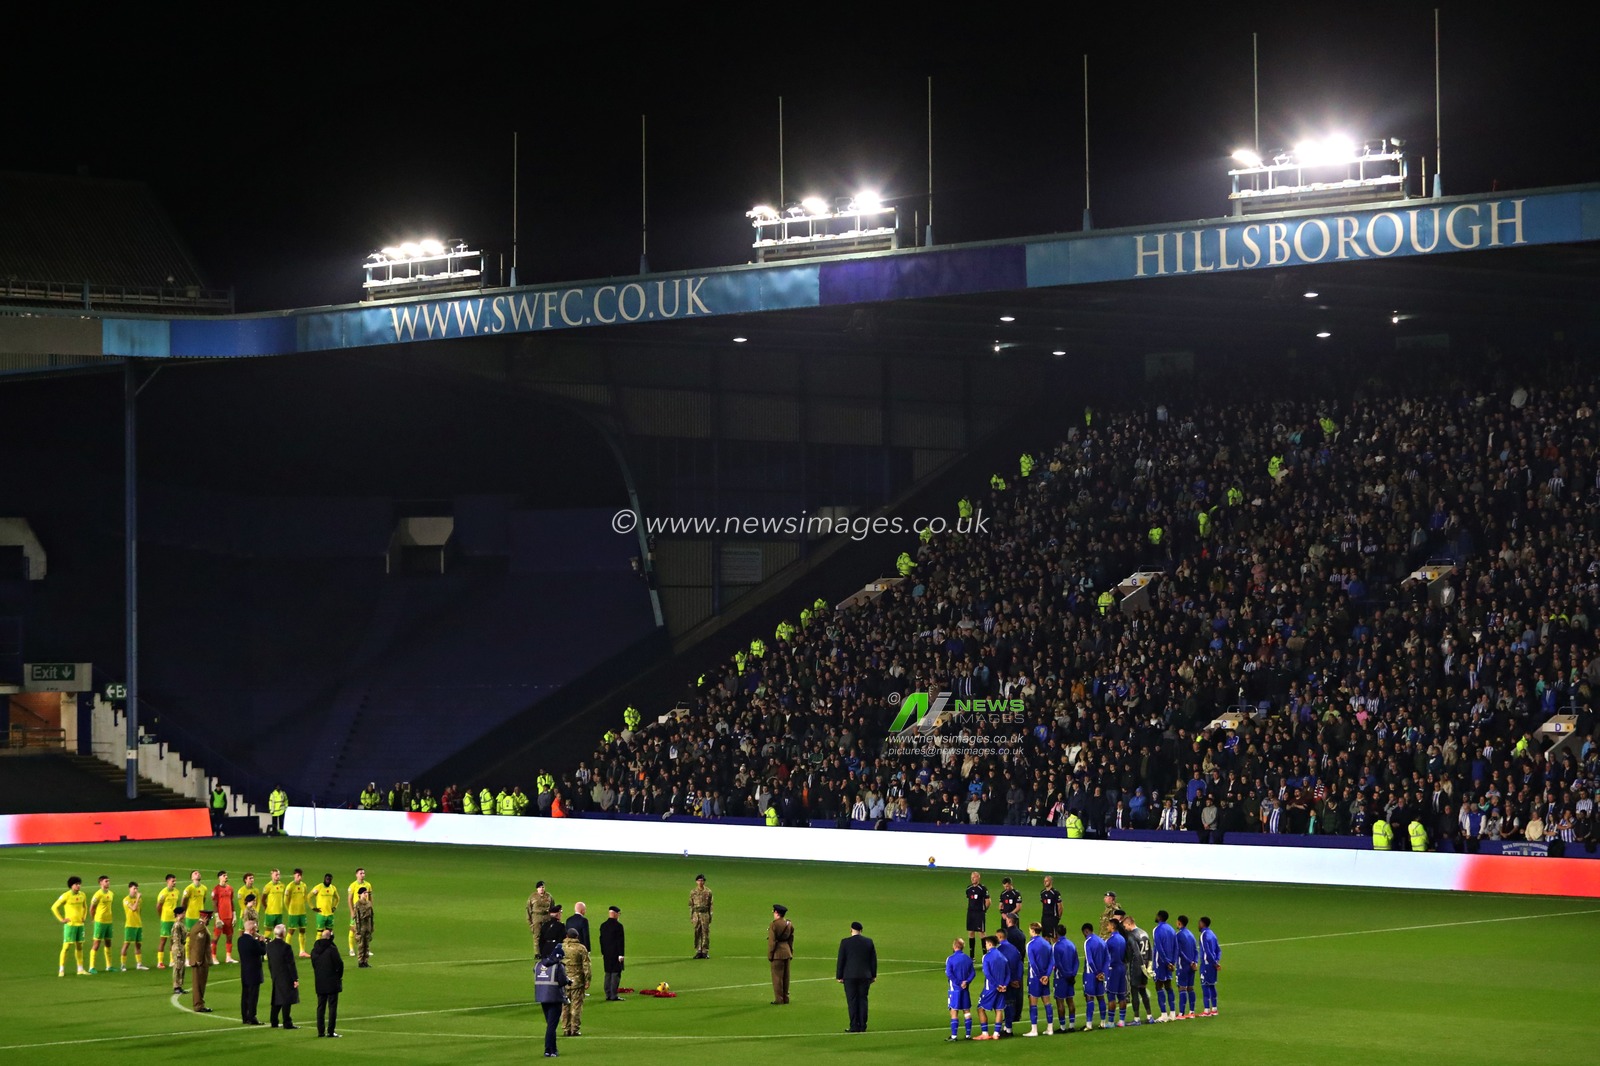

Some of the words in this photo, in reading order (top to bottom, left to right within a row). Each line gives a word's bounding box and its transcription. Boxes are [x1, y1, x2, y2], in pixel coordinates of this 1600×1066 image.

[1134, 199, 1528, 277] HILLSBOROUGH
[389, 276, 712, 341] WWW.SWFC.CO.UK
[32, 666, 58, 680] Exit
[1222, 720, 1226, 728] C
[1555, 723, 1561, 732] D
[1140, 940, 1149, 954] 24
